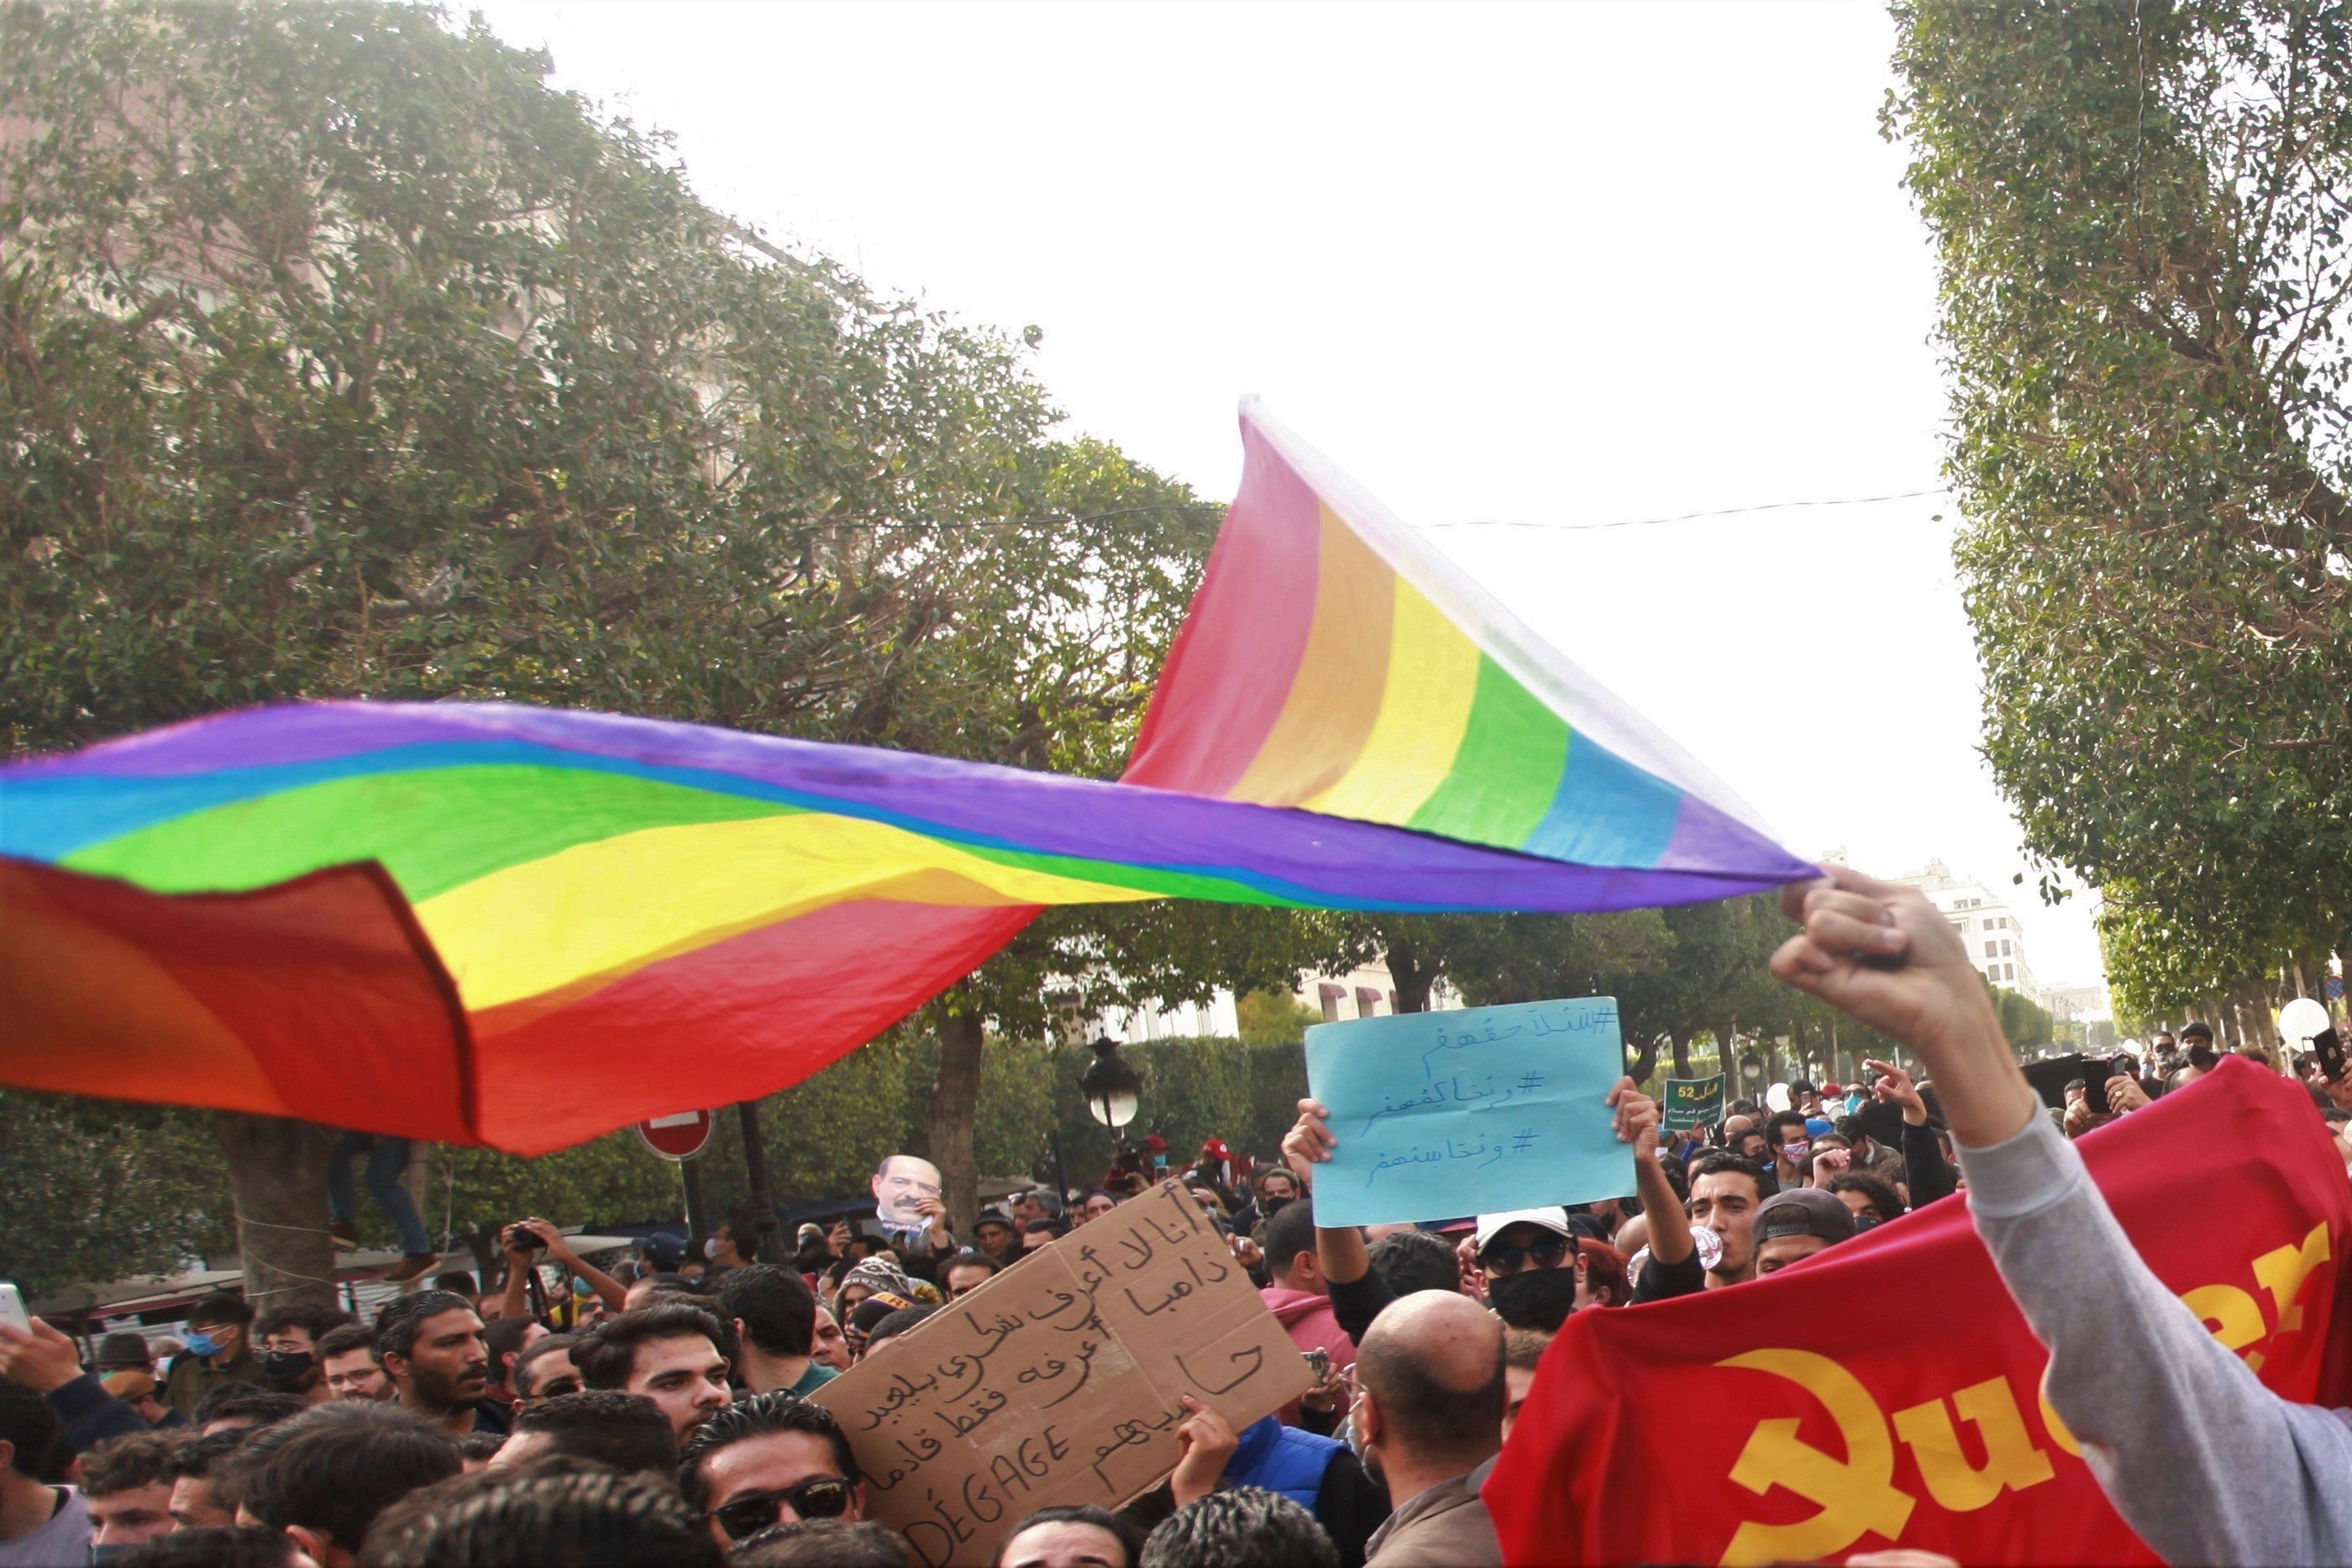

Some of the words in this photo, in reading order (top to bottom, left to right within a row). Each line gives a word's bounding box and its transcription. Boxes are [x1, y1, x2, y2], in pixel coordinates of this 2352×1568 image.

[1142, 1181, 1200, 1244] أنا
[1119, 1227, 1153, 1270] لا
[1027, 1245, 1114, 1332] أعرف
[1123, 1251, 1228, 1316] ذاهبا
[1017, 1314, 1112, 1409] أعرفه
[933, 1387, 1007, 1439] فقط
